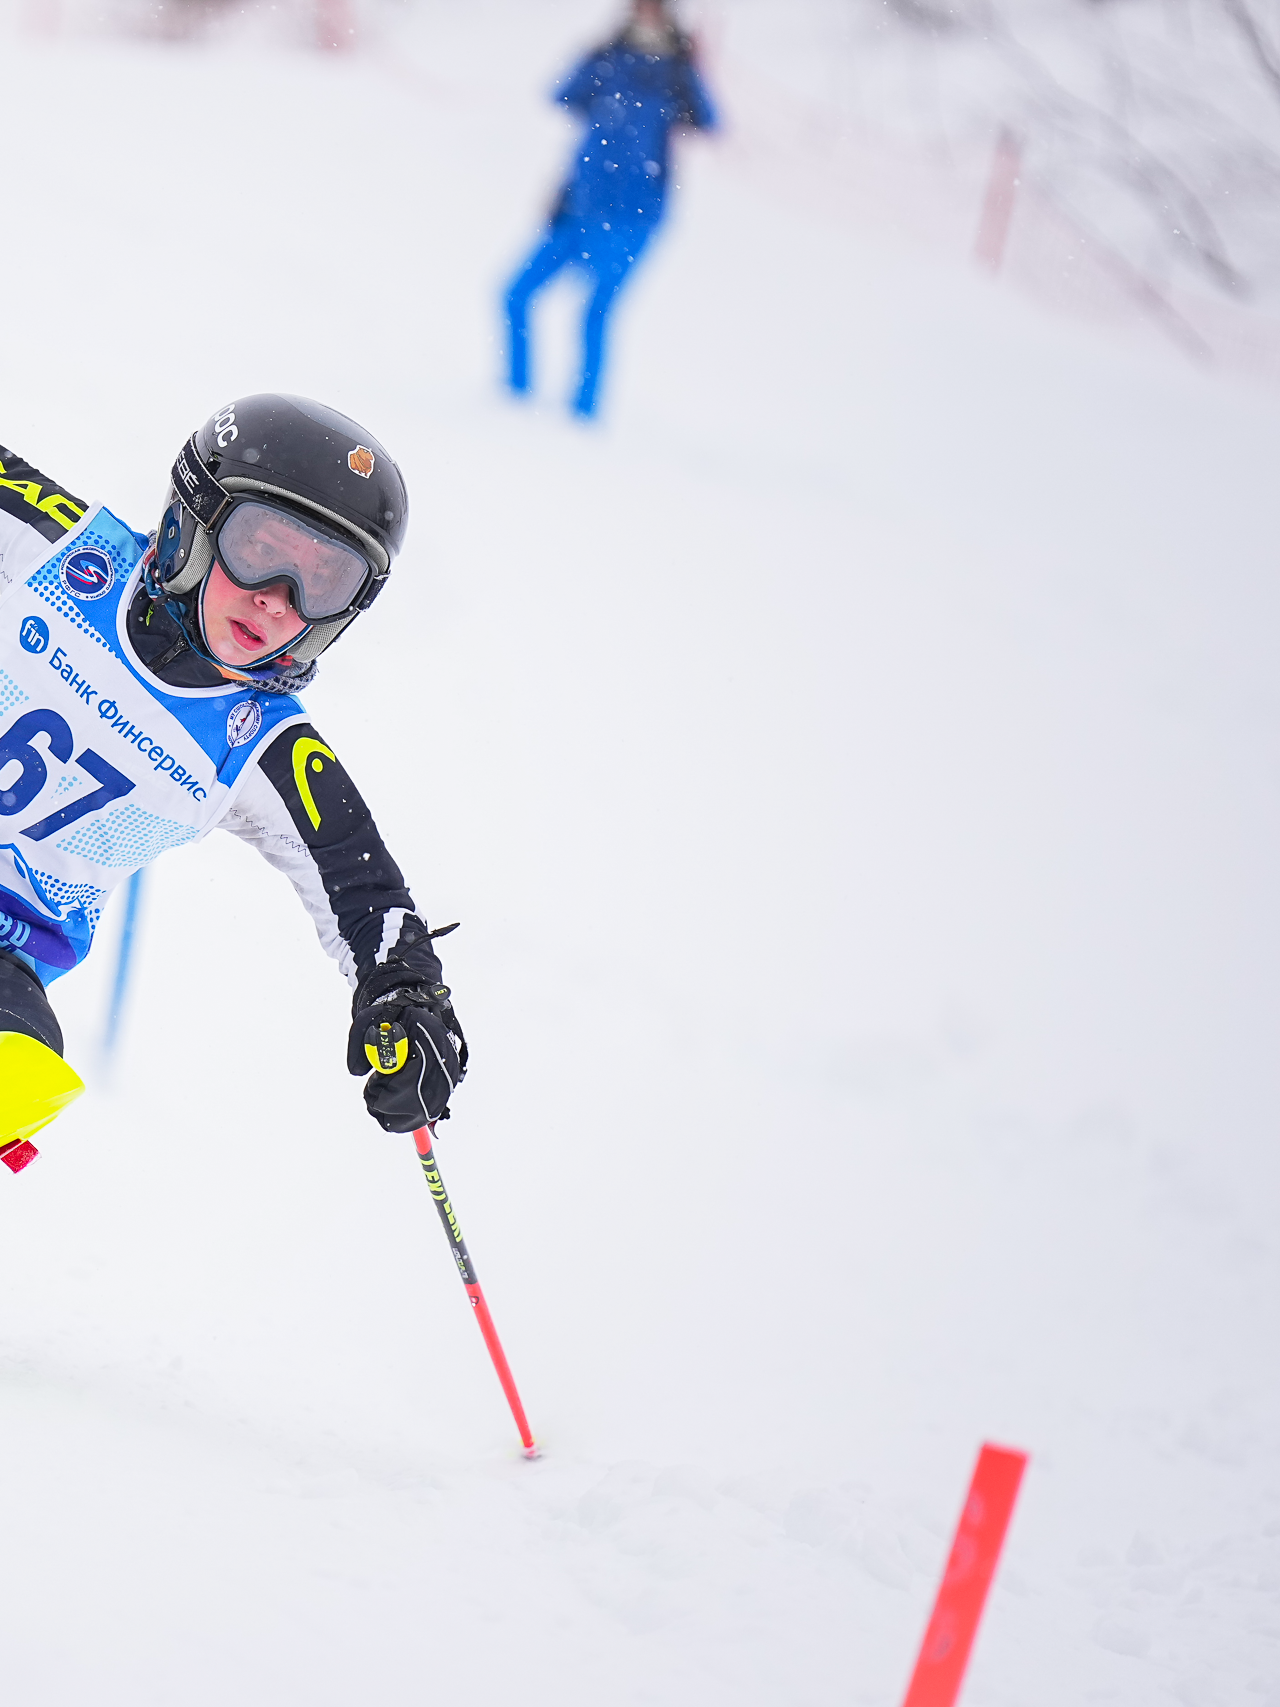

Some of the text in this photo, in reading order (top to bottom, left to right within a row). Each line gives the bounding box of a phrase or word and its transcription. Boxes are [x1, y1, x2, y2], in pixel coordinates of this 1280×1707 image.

[21, 619, 45, 652] fin
[48, 646, 207, 802] Банк Финсервис
